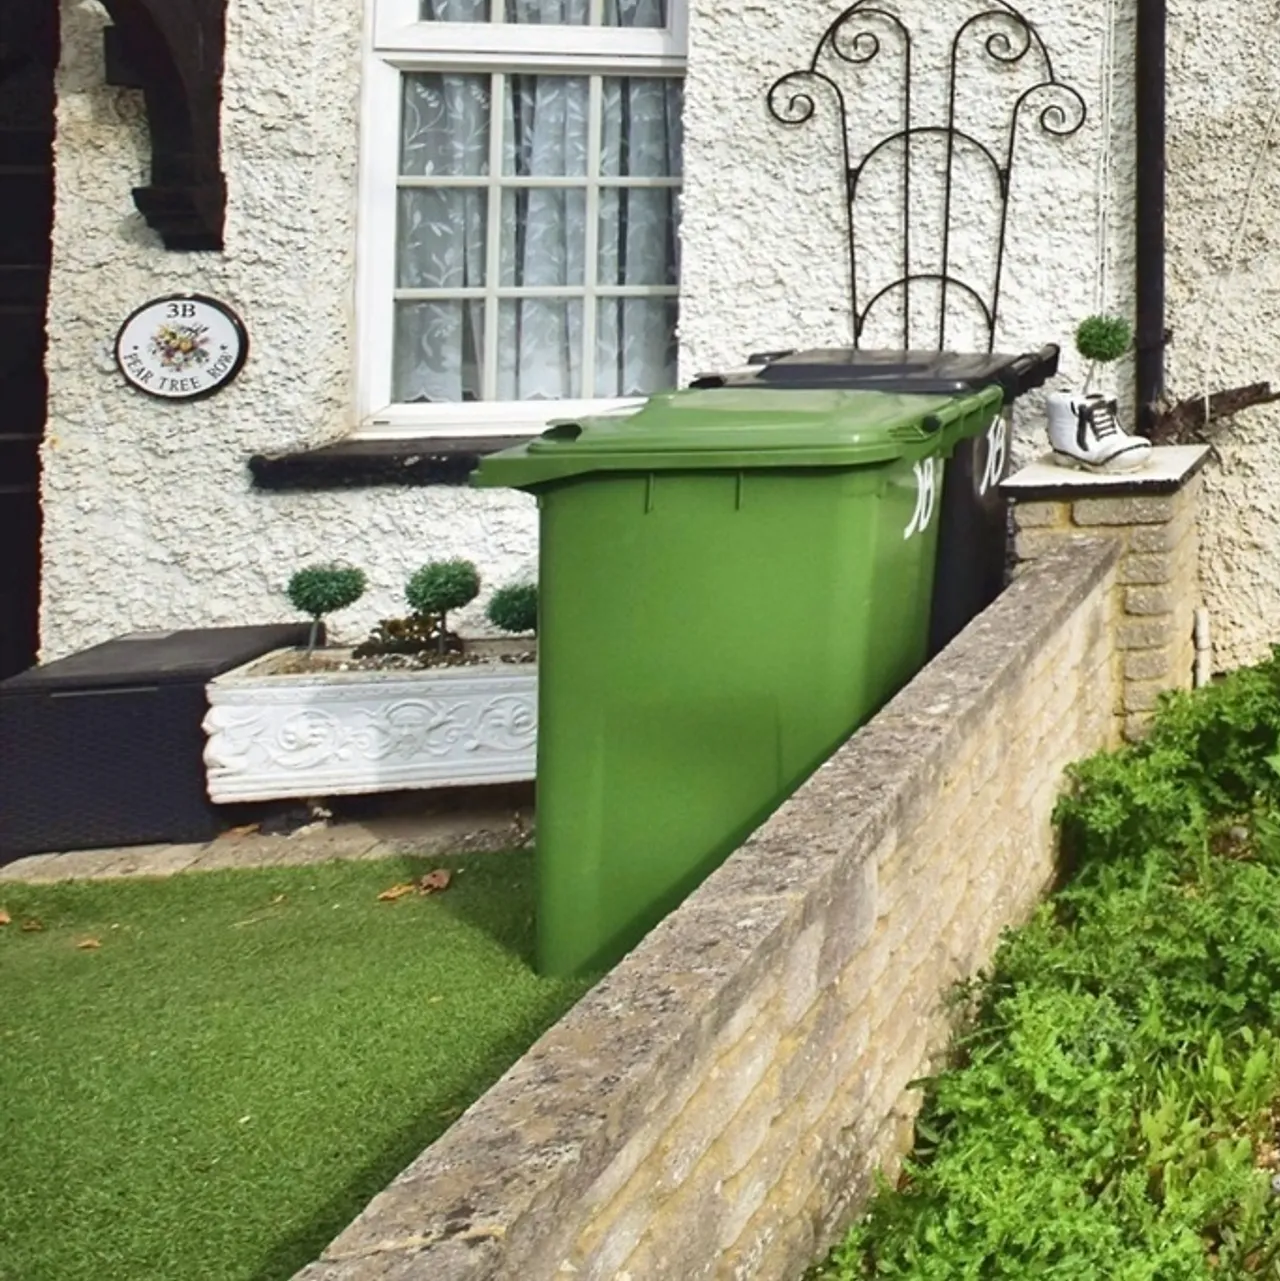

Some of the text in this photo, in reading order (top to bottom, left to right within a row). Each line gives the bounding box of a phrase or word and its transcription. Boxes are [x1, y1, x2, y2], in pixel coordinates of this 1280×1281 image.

[166, 303, 196, 319] 3B
[124, 352, 233, 392] PEAR TREE ROW
